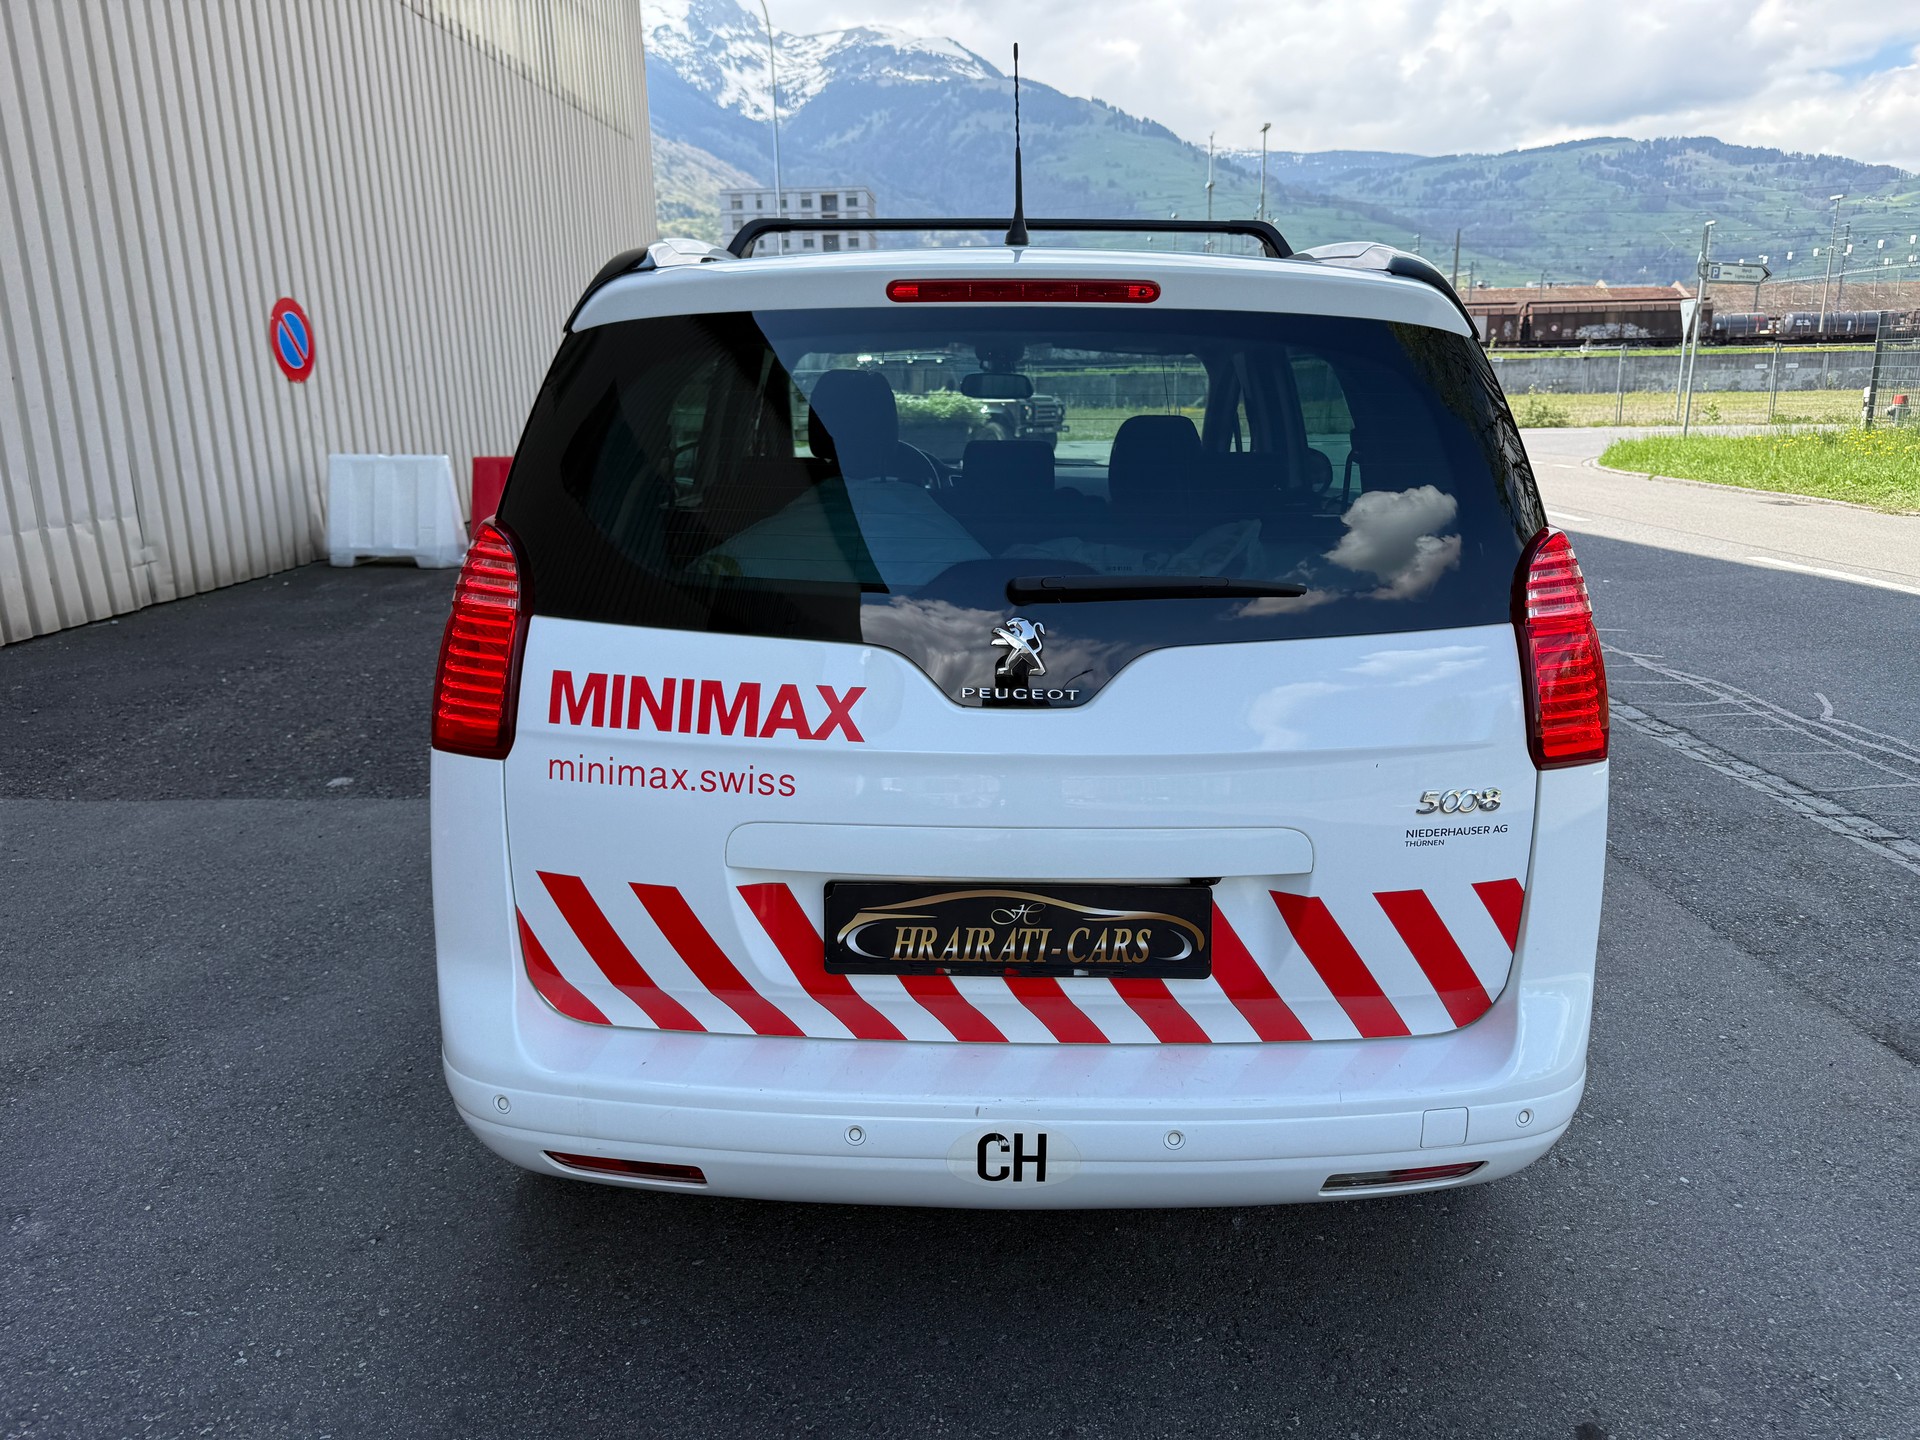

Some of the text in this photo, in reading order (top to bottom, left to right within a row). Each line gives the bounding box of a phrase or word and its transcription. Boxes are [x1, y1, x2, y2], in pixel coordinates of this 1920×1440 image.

[548, 669, 867, 743] MINIMAX
[961, 687, 1080, 701] PEUGEOT
[548, 753, 797, 797] minimax.swiss
[1415, 786, 1502, 815] 5008
[1404, 838, 1445, 848] THÜRNEN
[1405, 824, 1508, 839] NIEDERHAUSER AG
[976, 1132, 1048, 1182] CH
